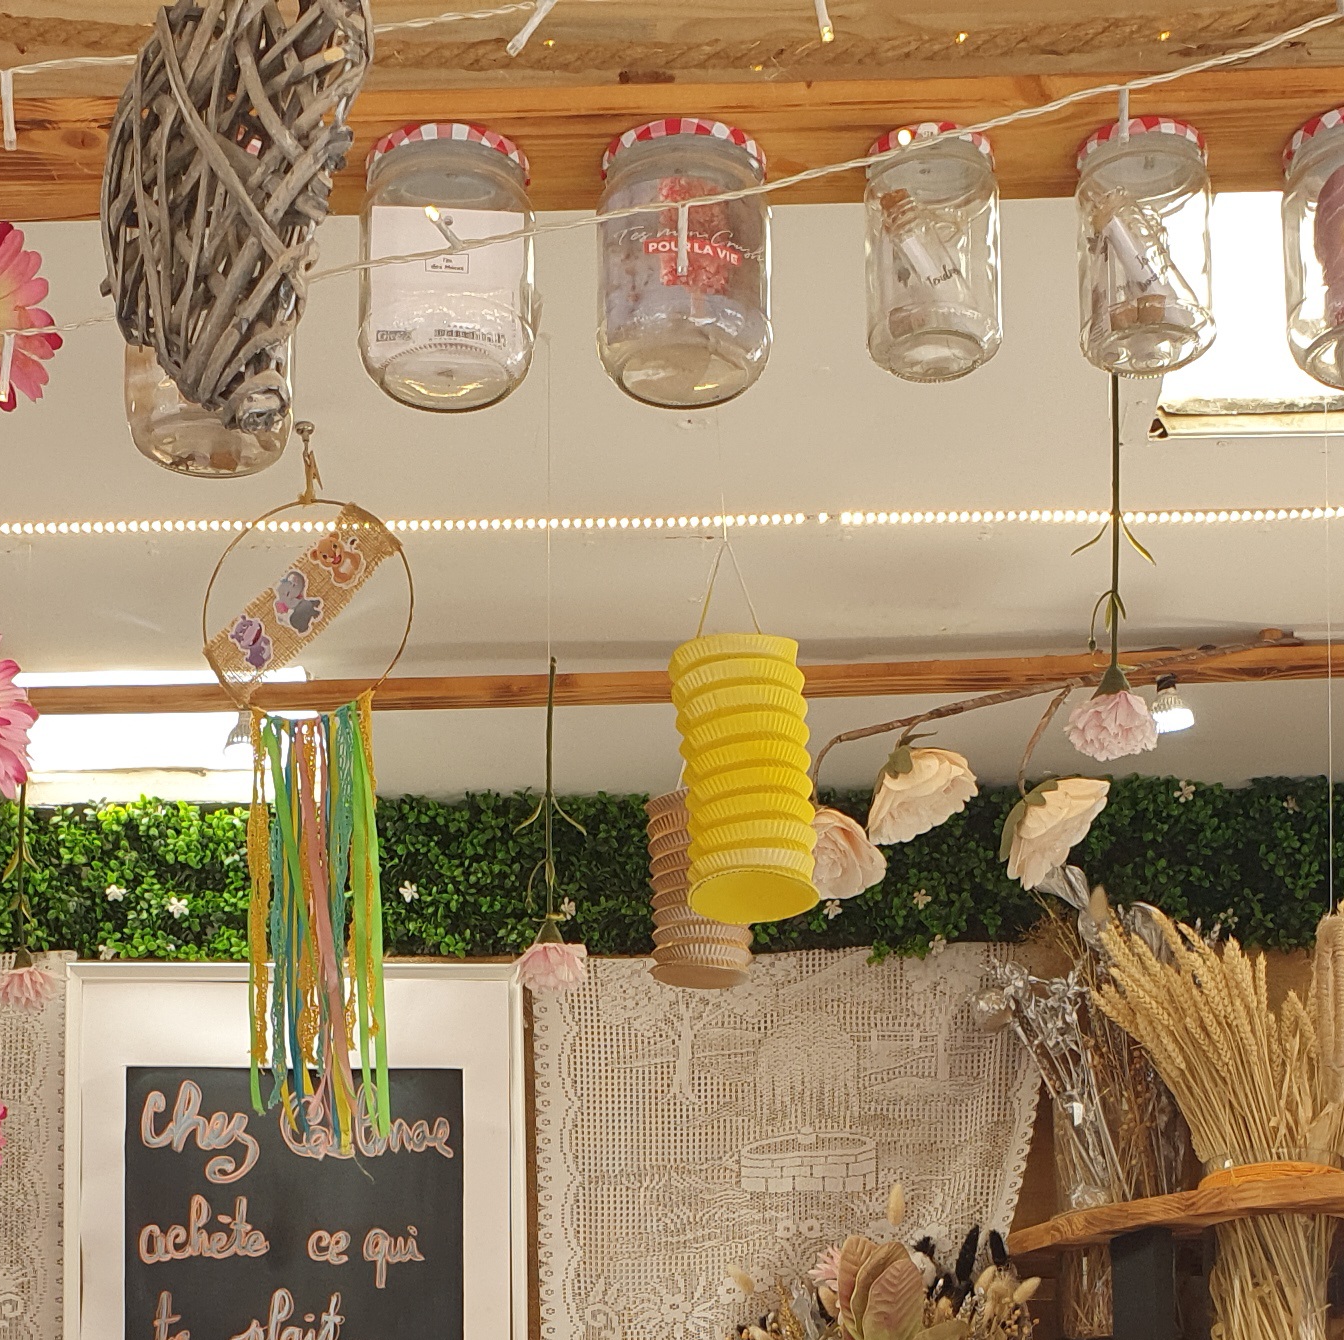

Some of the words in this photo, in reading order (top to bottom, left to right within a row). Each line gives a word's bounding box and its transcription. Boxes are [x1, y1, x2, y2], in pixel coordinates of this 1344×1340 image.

[716, 249, 739, 266] VIE
[141, 1080, 260, 1184] Chez
[306, 1229, 351, 1265] ce
[362, 1225, 426, 1289] qui
